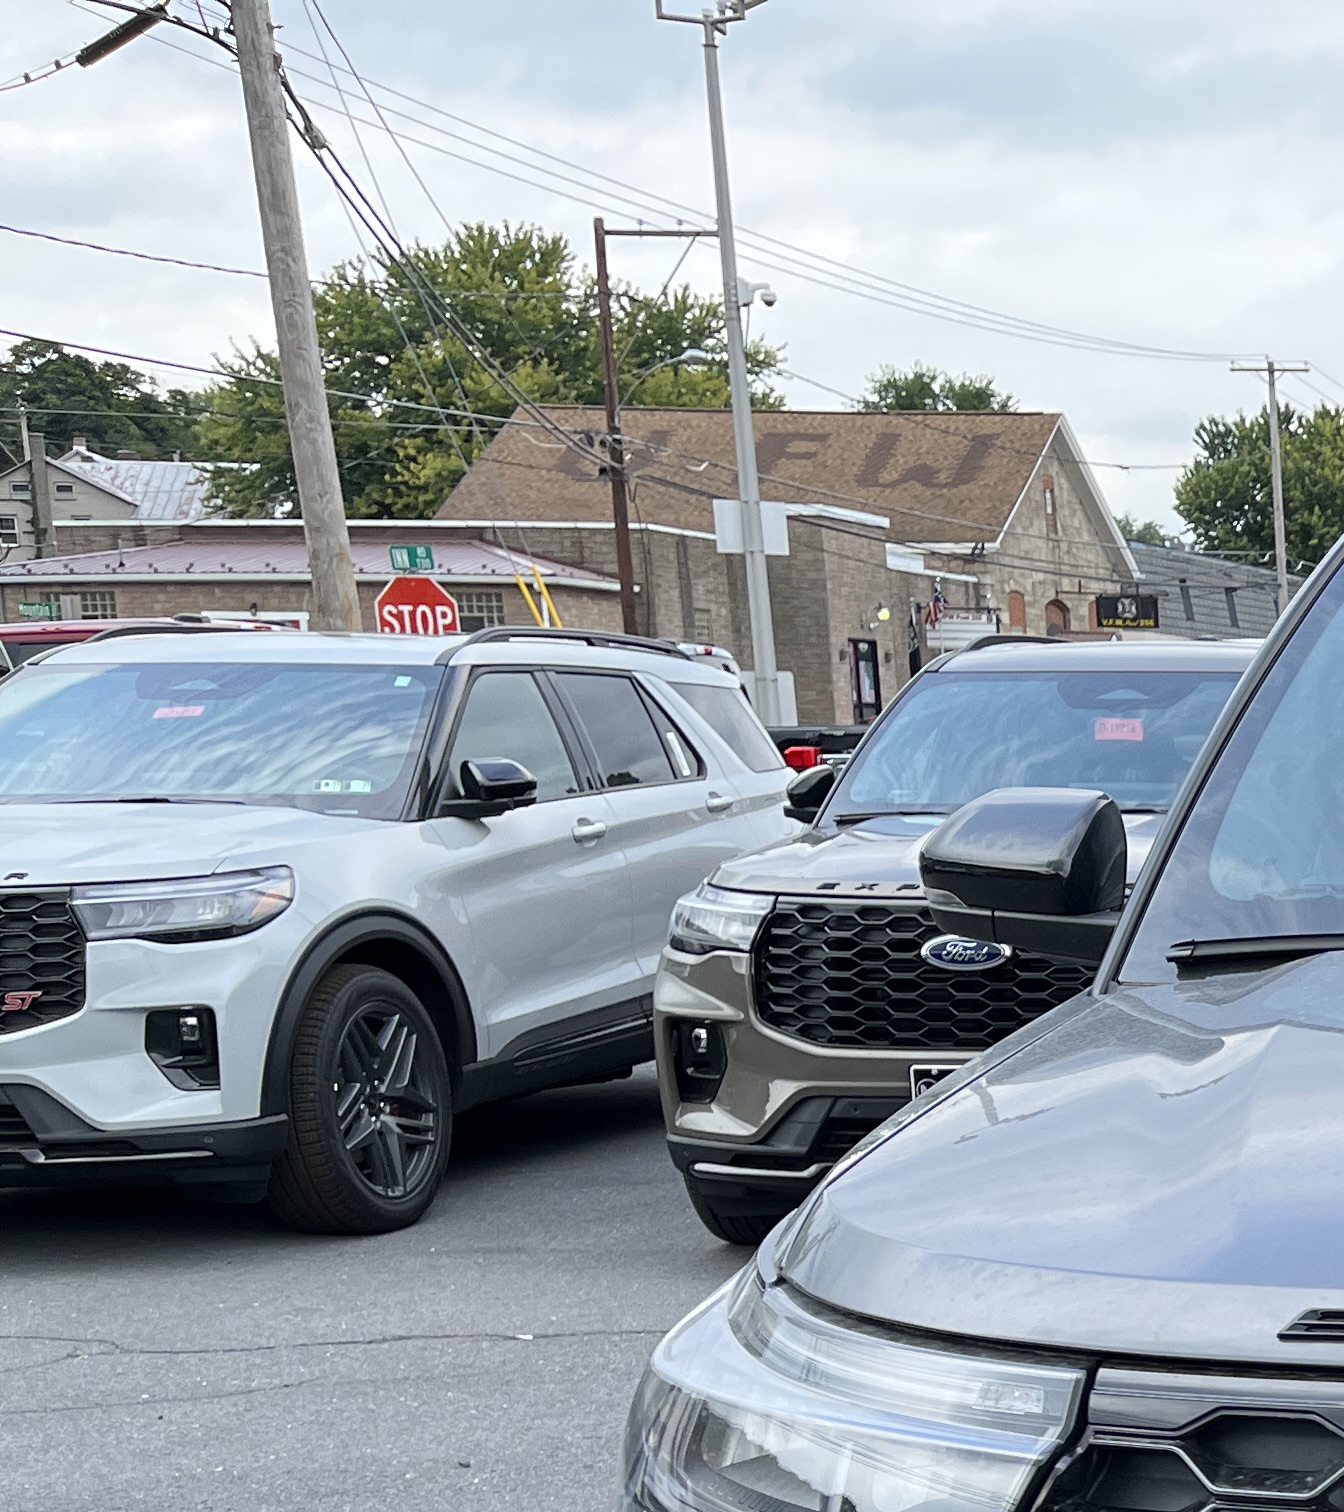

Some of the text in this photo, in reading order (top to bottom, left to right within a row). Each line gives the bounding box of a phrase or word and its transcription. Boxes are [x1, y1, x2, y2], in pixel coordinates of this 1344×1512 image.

[382, 604, 453, 635] STOP
[941, 941, 989, 961] Ford
[2, 990, 43, 1011] ST
